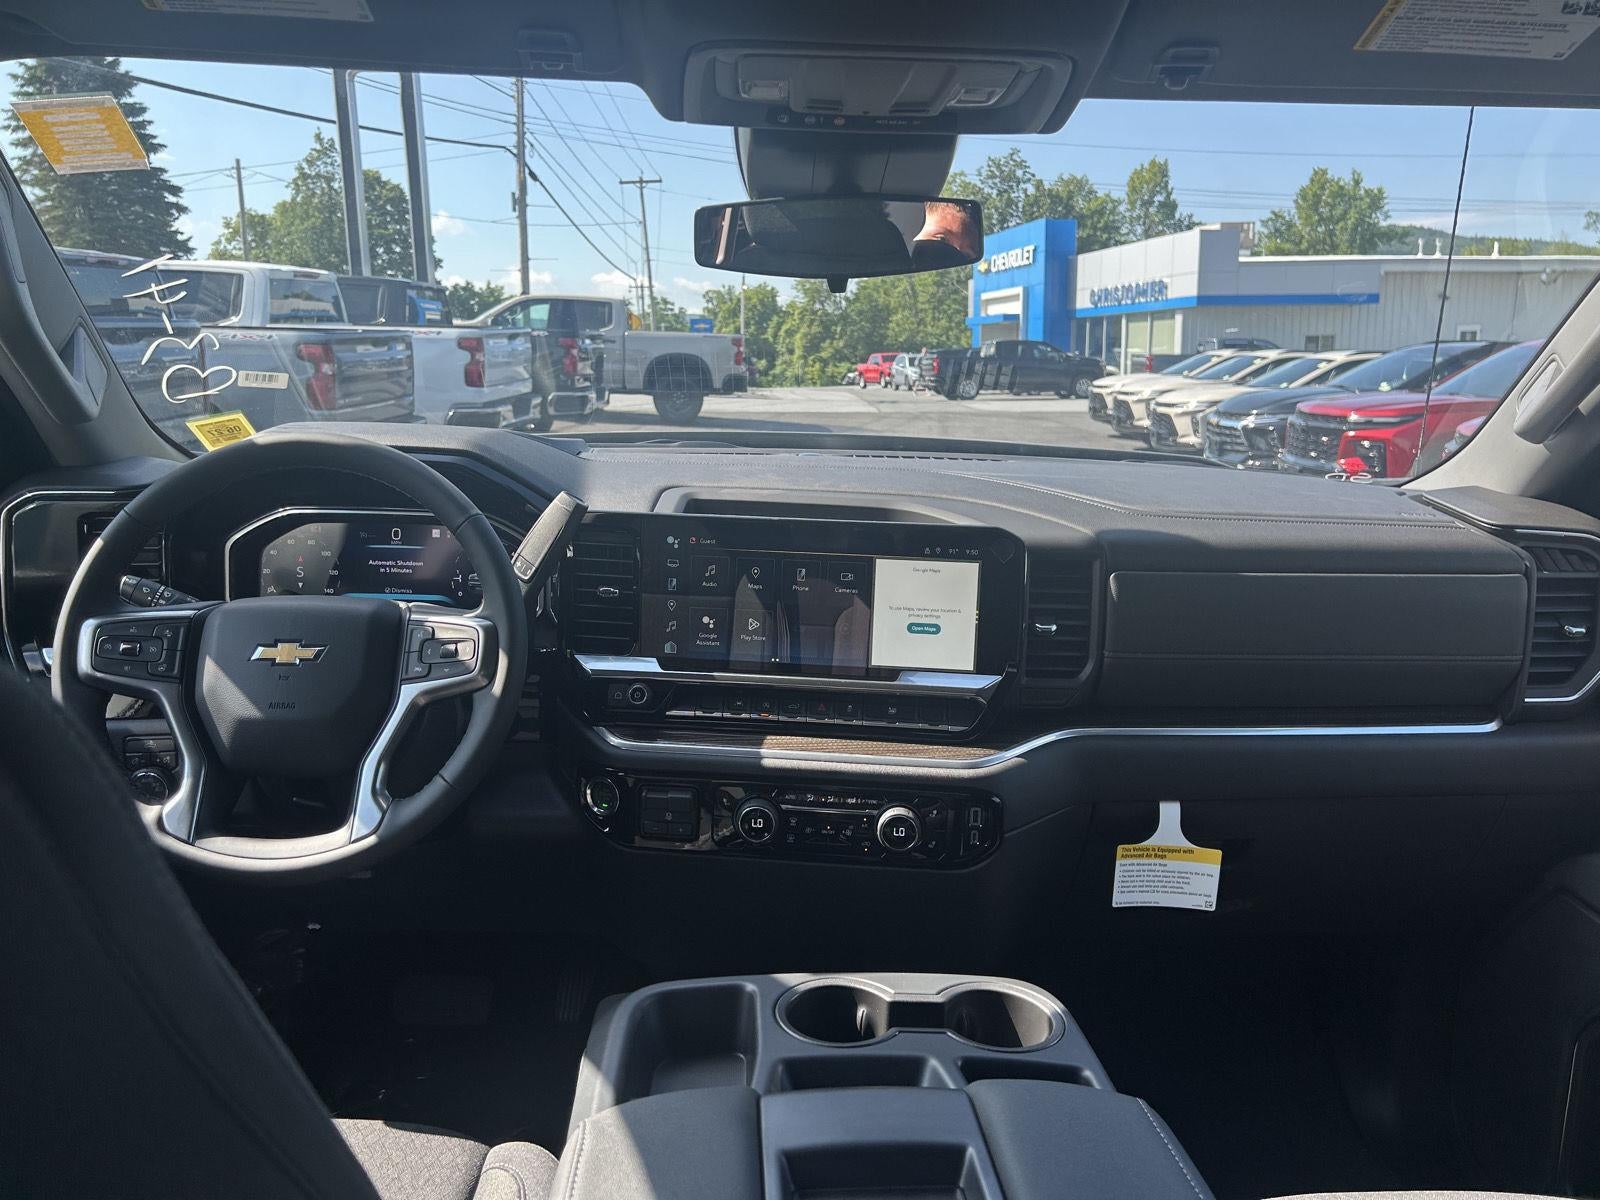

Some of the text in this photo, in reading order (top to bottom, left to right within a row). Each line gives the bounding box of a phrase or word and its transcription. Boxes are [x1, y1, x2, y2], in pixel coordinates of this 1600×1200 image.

[990, 245, 1036, 272] CHEVROLET
[751, 818, 763, 828] LO
[893, 827, 905, 837] LO
